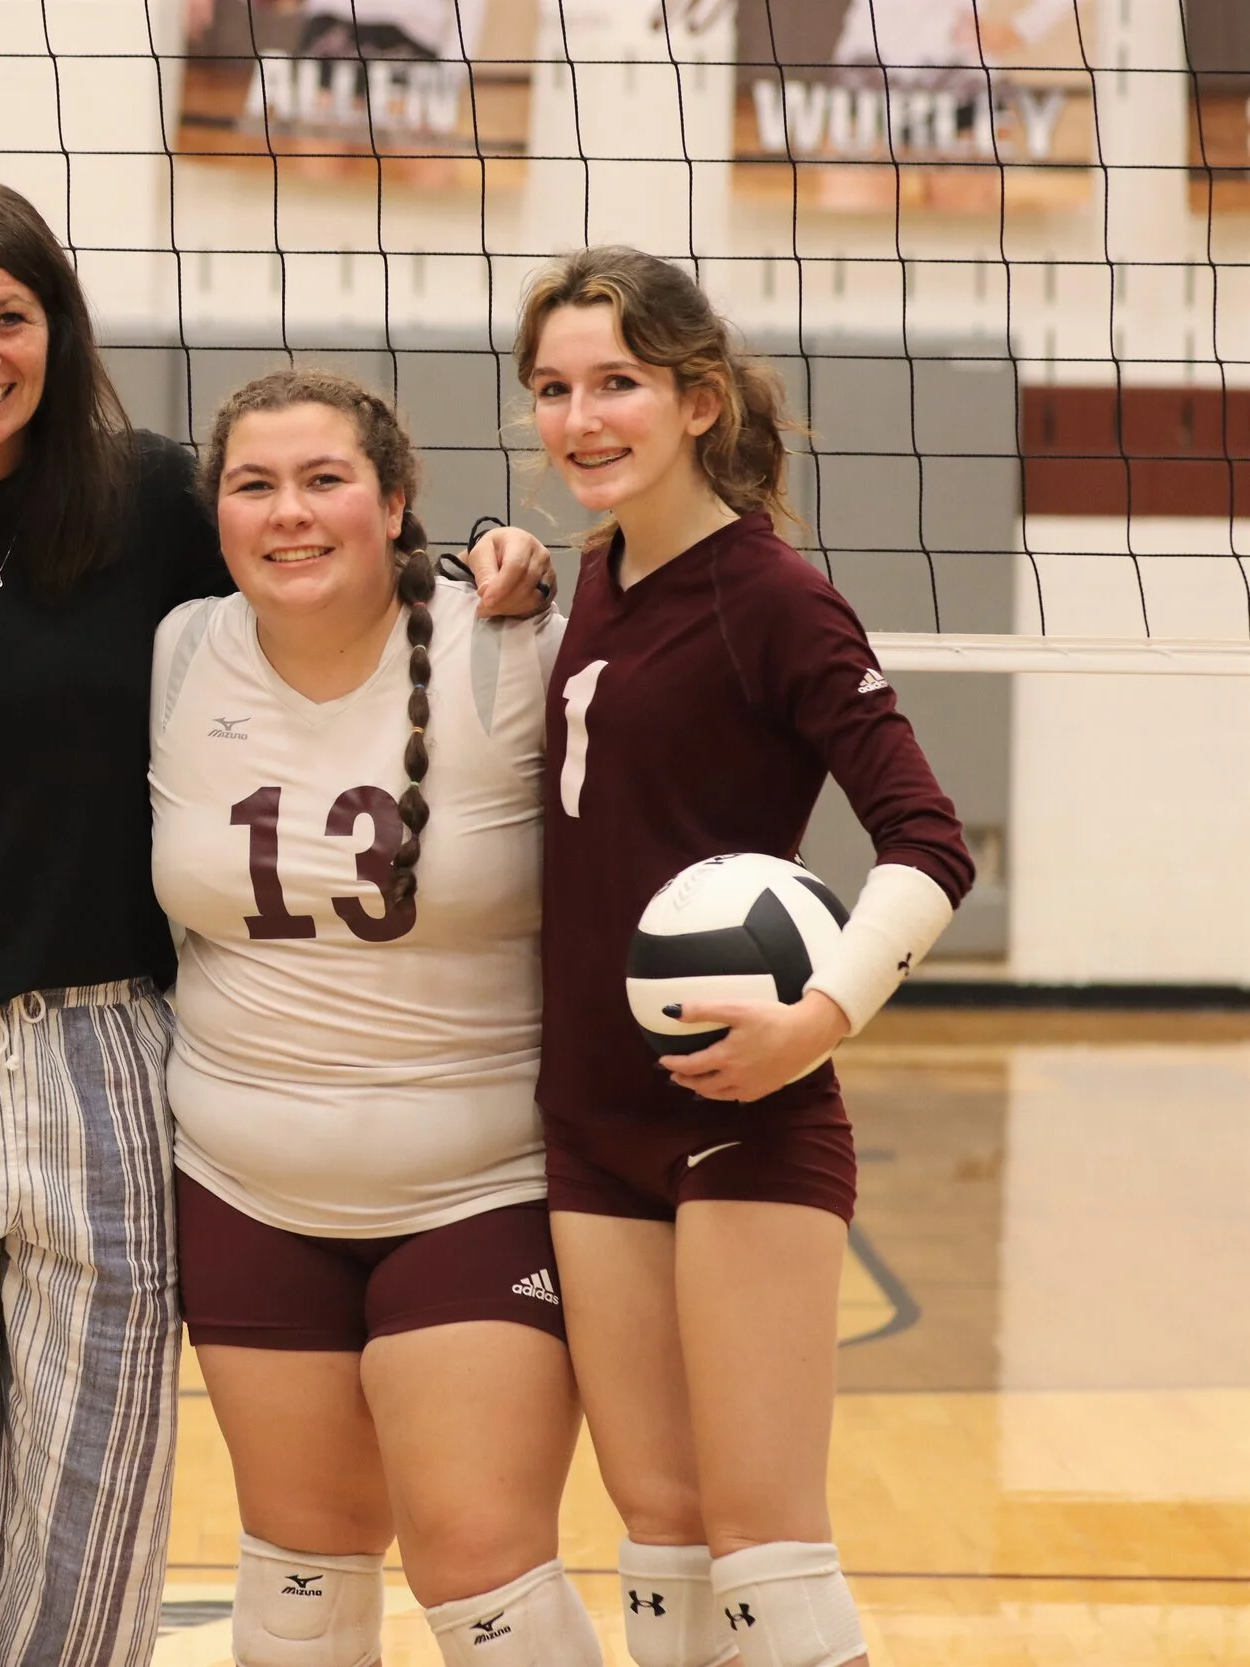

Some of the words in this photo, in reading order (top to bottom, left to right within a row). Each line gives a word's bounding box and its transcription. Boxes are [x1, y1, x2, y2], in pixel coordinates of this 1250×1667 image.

[244, 52, 459, 133] ALLEN
[562, 659, 610, 819] 1
[230, 785, 418, 943] 13
[511, 1283, 560, 1306] adidas
